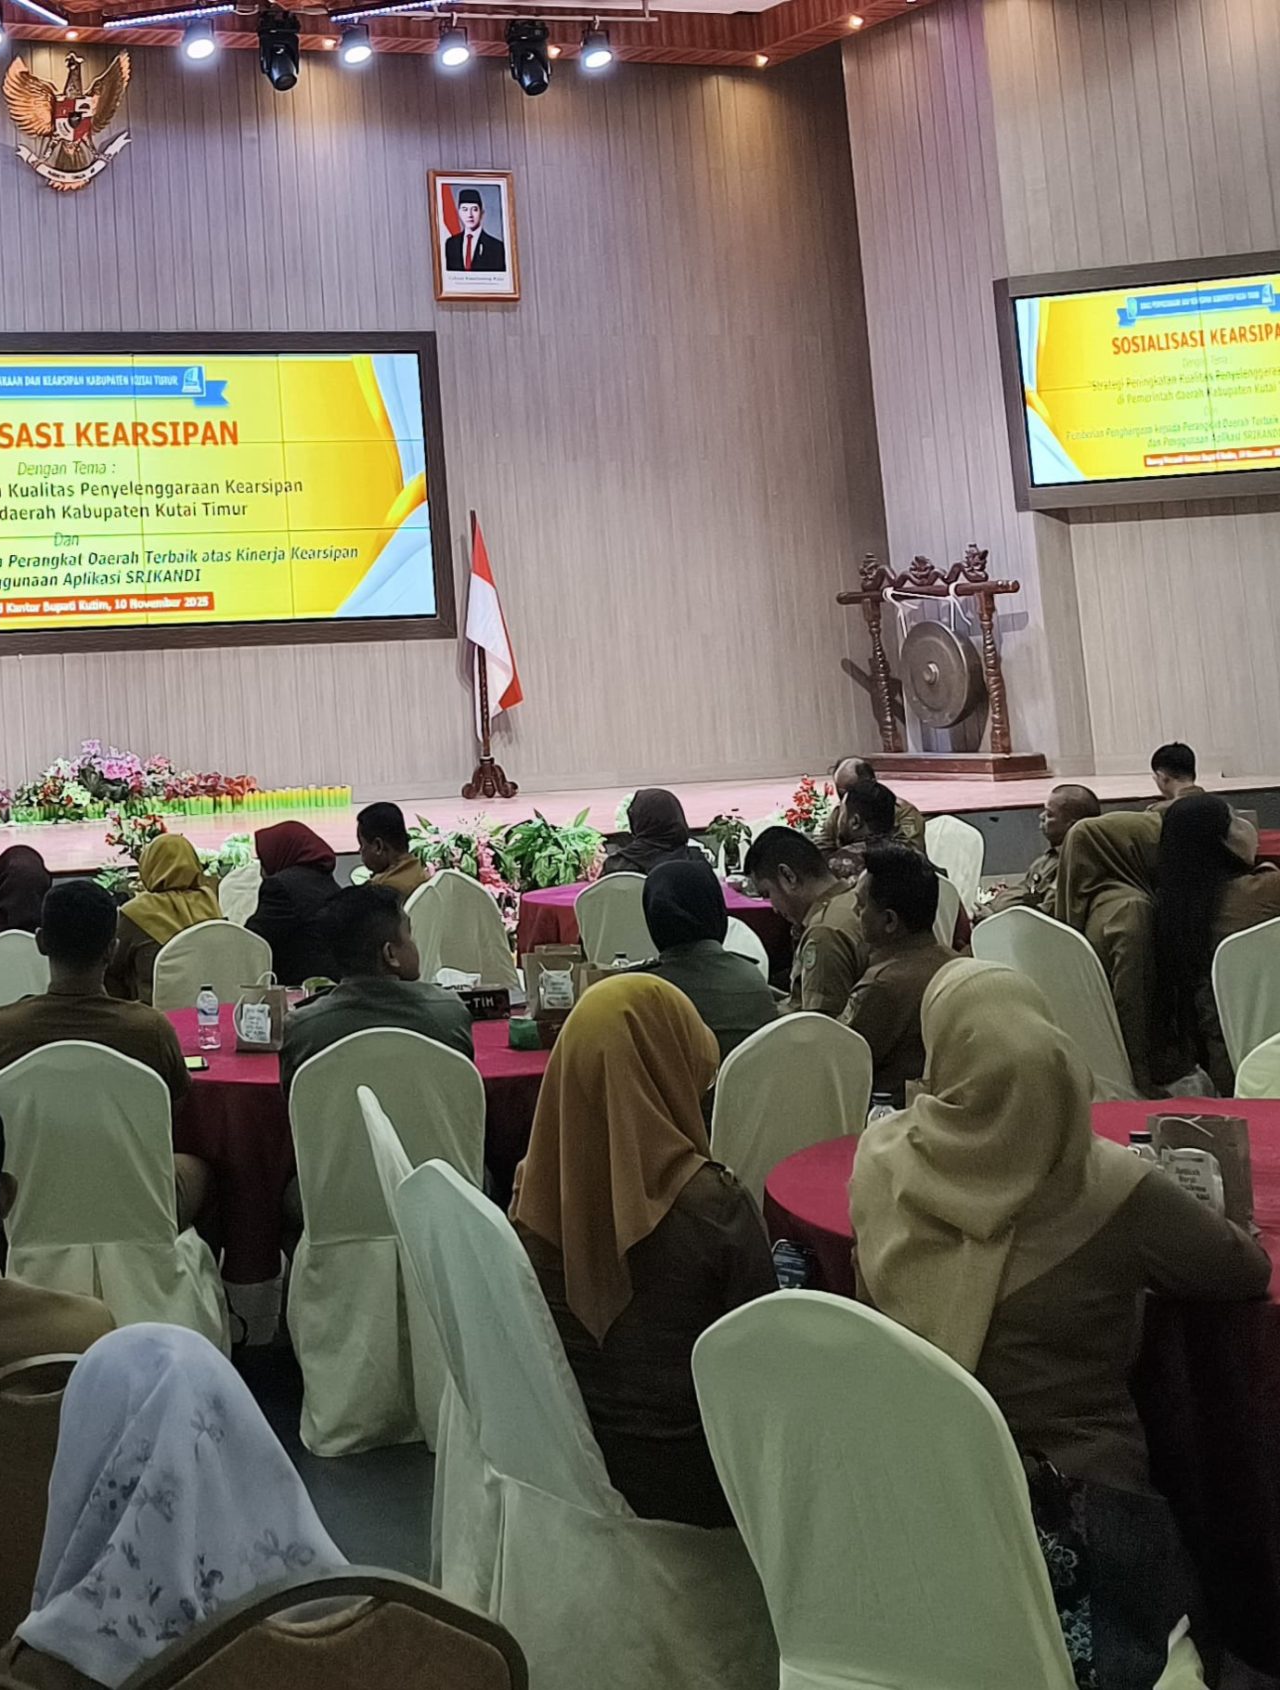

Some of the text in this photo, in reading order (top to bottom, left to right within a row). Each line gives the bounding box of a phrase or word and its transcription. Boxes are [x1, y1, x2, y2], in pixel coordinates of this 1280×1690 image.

[1111, 330, 1206, 355] SOSIALISASI
[75, 420, 239, 447] KEARSIPAN
[17, 460, 67, 479] Dengan
[73, 460, 107, 475] Tema
[8, 481, 75, 499] Kualitas
[80, 480, 220, 500] Penyelenggaraan
[225, 479, 303, 496] Kearsipan
[0, 505, 56, 520] daerah
[62, 503, 150, 522] Kabupaten
[155, 502, 197, 518] Kutai
[202, 501, 248, 516] Timur
[53, 531, 80, 547] Dan
[8, 551, 83, 571] Perangkat
[88, 550, 140, 566] Daerah
[146, 549, 198, 565] Terbaik
[202, 550, 231, 563] atas
[236, 547, 286, 564] Kinerja
[291, 546, 359, 563] Kearsipan
[62, 569, 121, 588] Aplikasi
[126, 568, 201, 585] SRIKANDI
[129, 596, 181, 610] November
